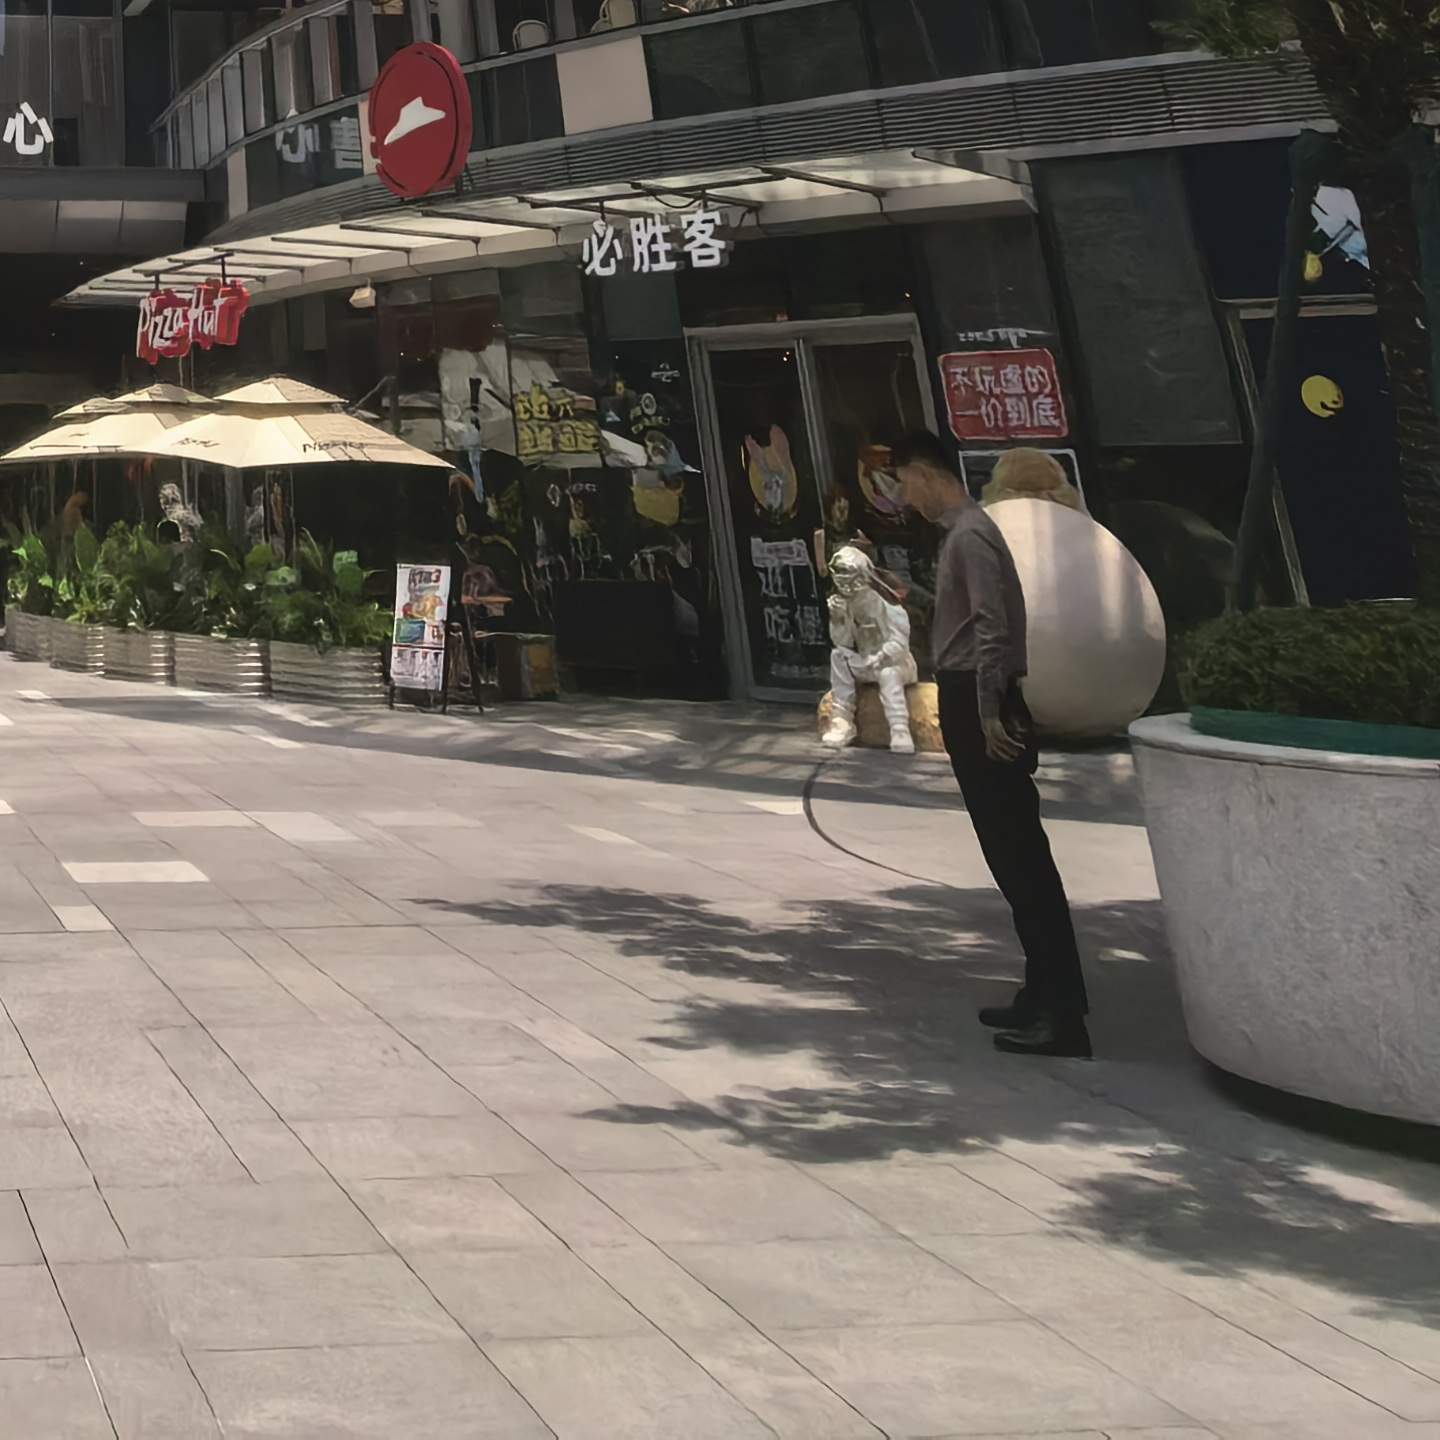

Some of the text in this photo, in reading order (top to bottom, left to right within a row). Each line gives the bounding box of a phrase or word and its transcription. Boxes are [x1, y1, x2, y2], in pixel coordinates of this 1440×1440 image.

[582, 208, 727, 277] 必胜客
[136, 286, 228, 358] Pizza Hut
[949, 364, 1052, 395] 不玩虚的
[955, 394, 1061, 428] 一价到底
